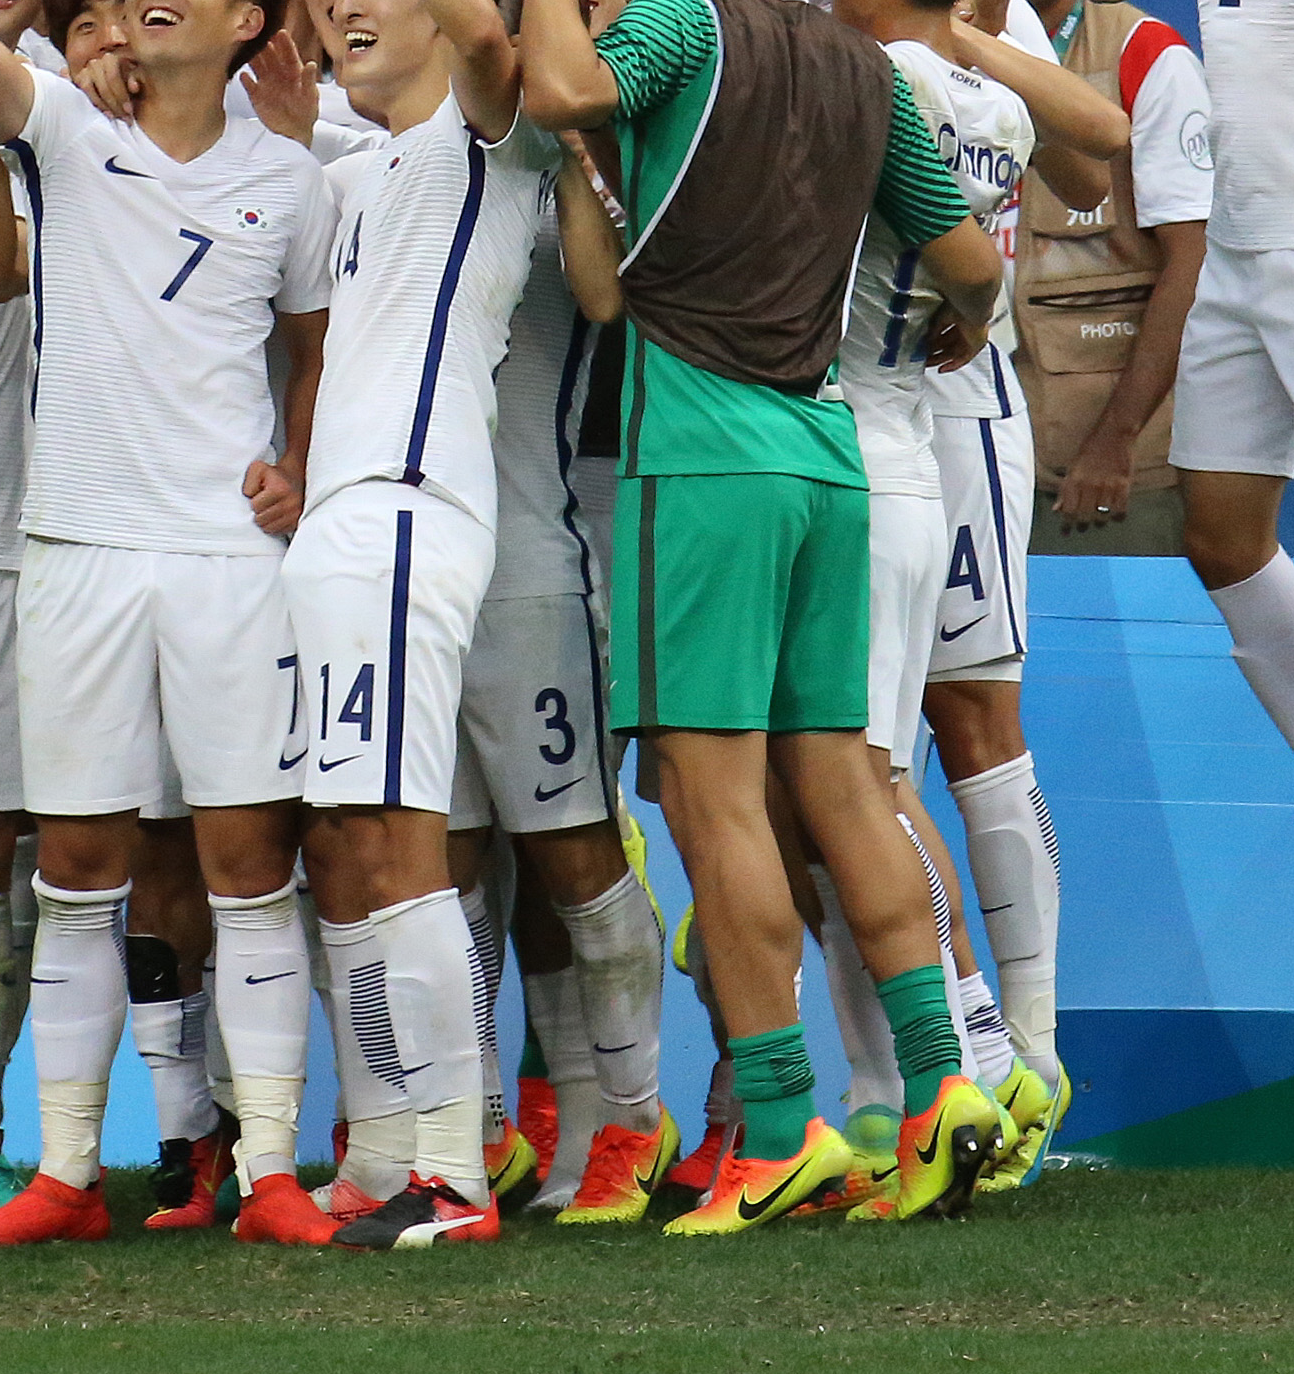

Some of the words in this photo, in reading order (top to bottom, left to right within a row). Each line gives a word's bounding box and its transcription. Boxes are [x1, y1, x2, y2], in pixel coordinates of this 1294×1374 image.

[949, 69, 982, 91] KOREA
[159, 227, 214, 302] 7
[1080, 322, 1137, 340] PHOTO
[945, 524, 985, 601] 4
[319, 662, 375, 743] 14
[534, 687, 576, 766] 3
